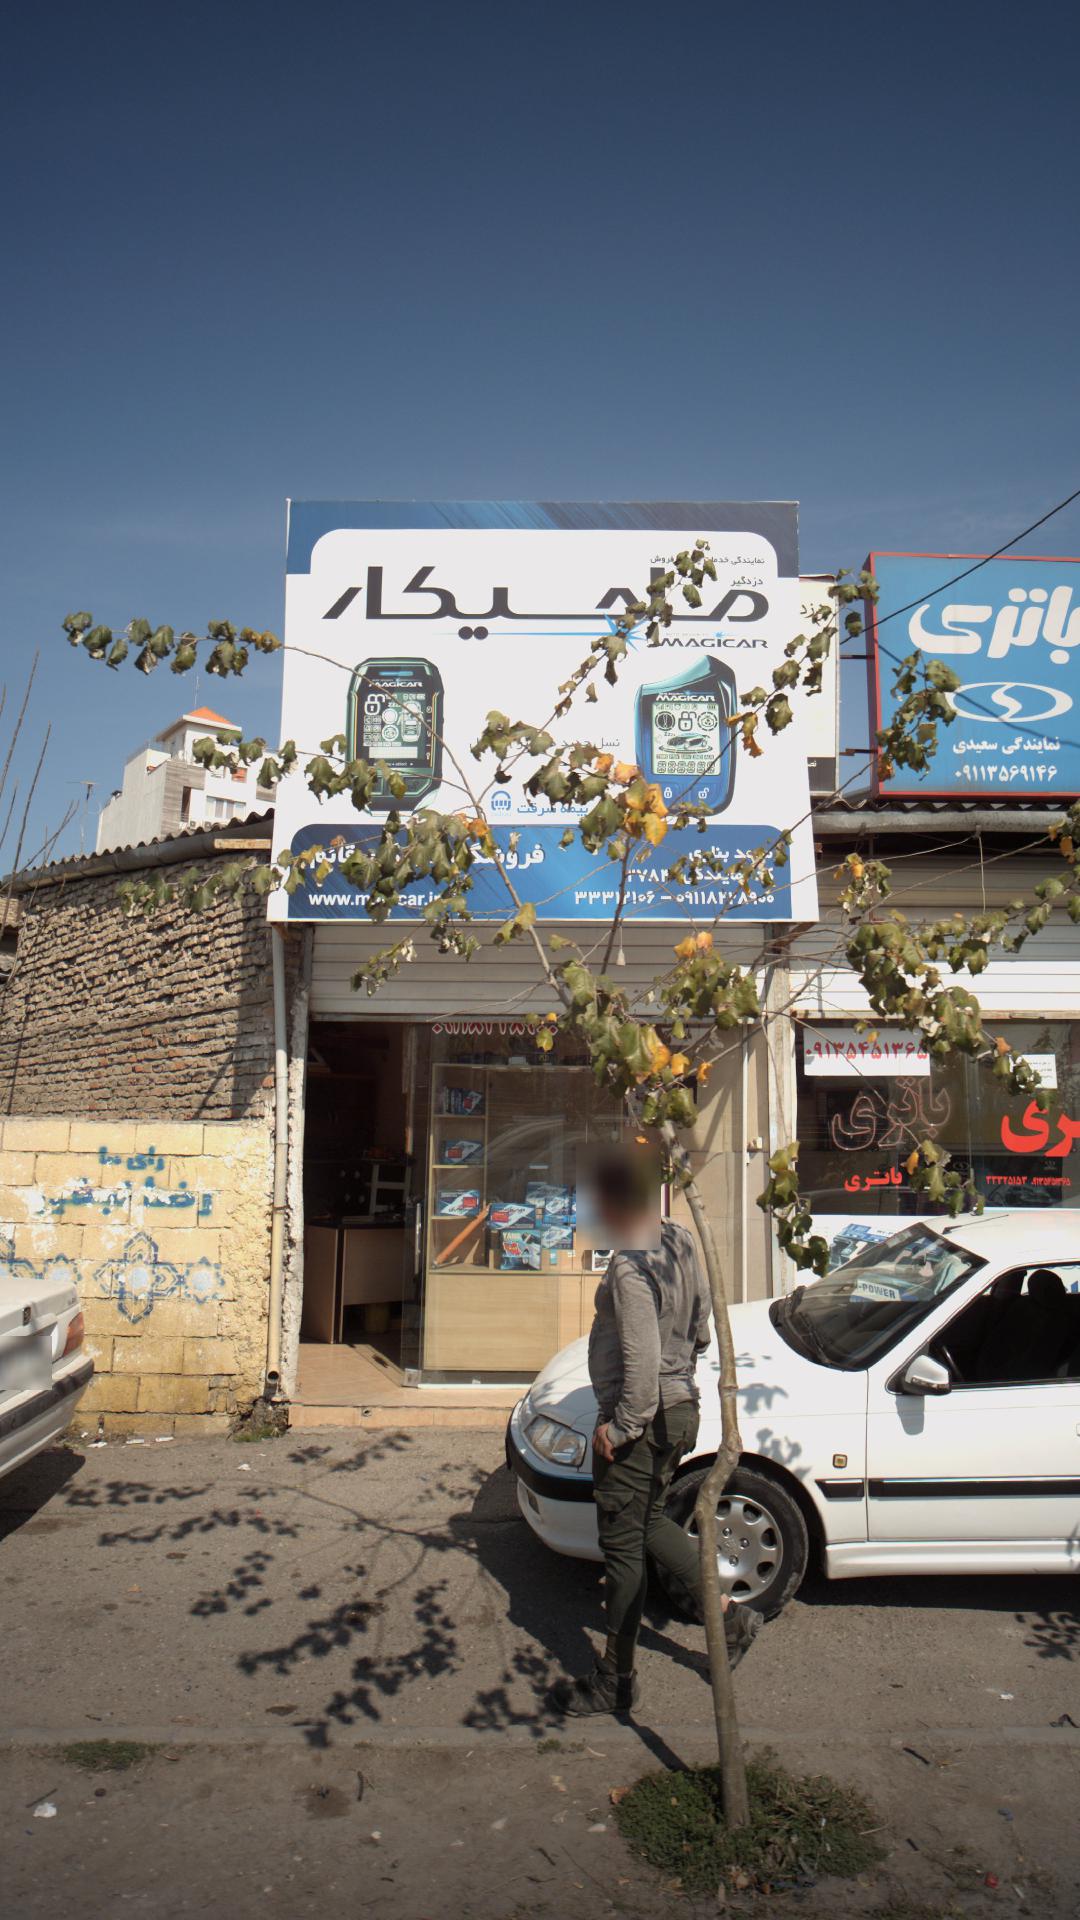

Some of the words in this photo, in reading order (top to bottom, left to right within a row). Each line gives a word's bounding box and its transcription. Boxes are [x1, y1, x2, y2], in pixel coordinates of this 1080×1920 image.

[731, 576, 764, 587] دزدگیر
[659, 637, 769, 649] MAGICAR
[953, 739, 998, 754] سعیدی
[1002, 736, 1061, 755] نمایندگی
[955, 764, 1058, 783] ۰۹۱۱۳۵۶۹۱۴۶
[844, 1167, 903, 1192] باتری
